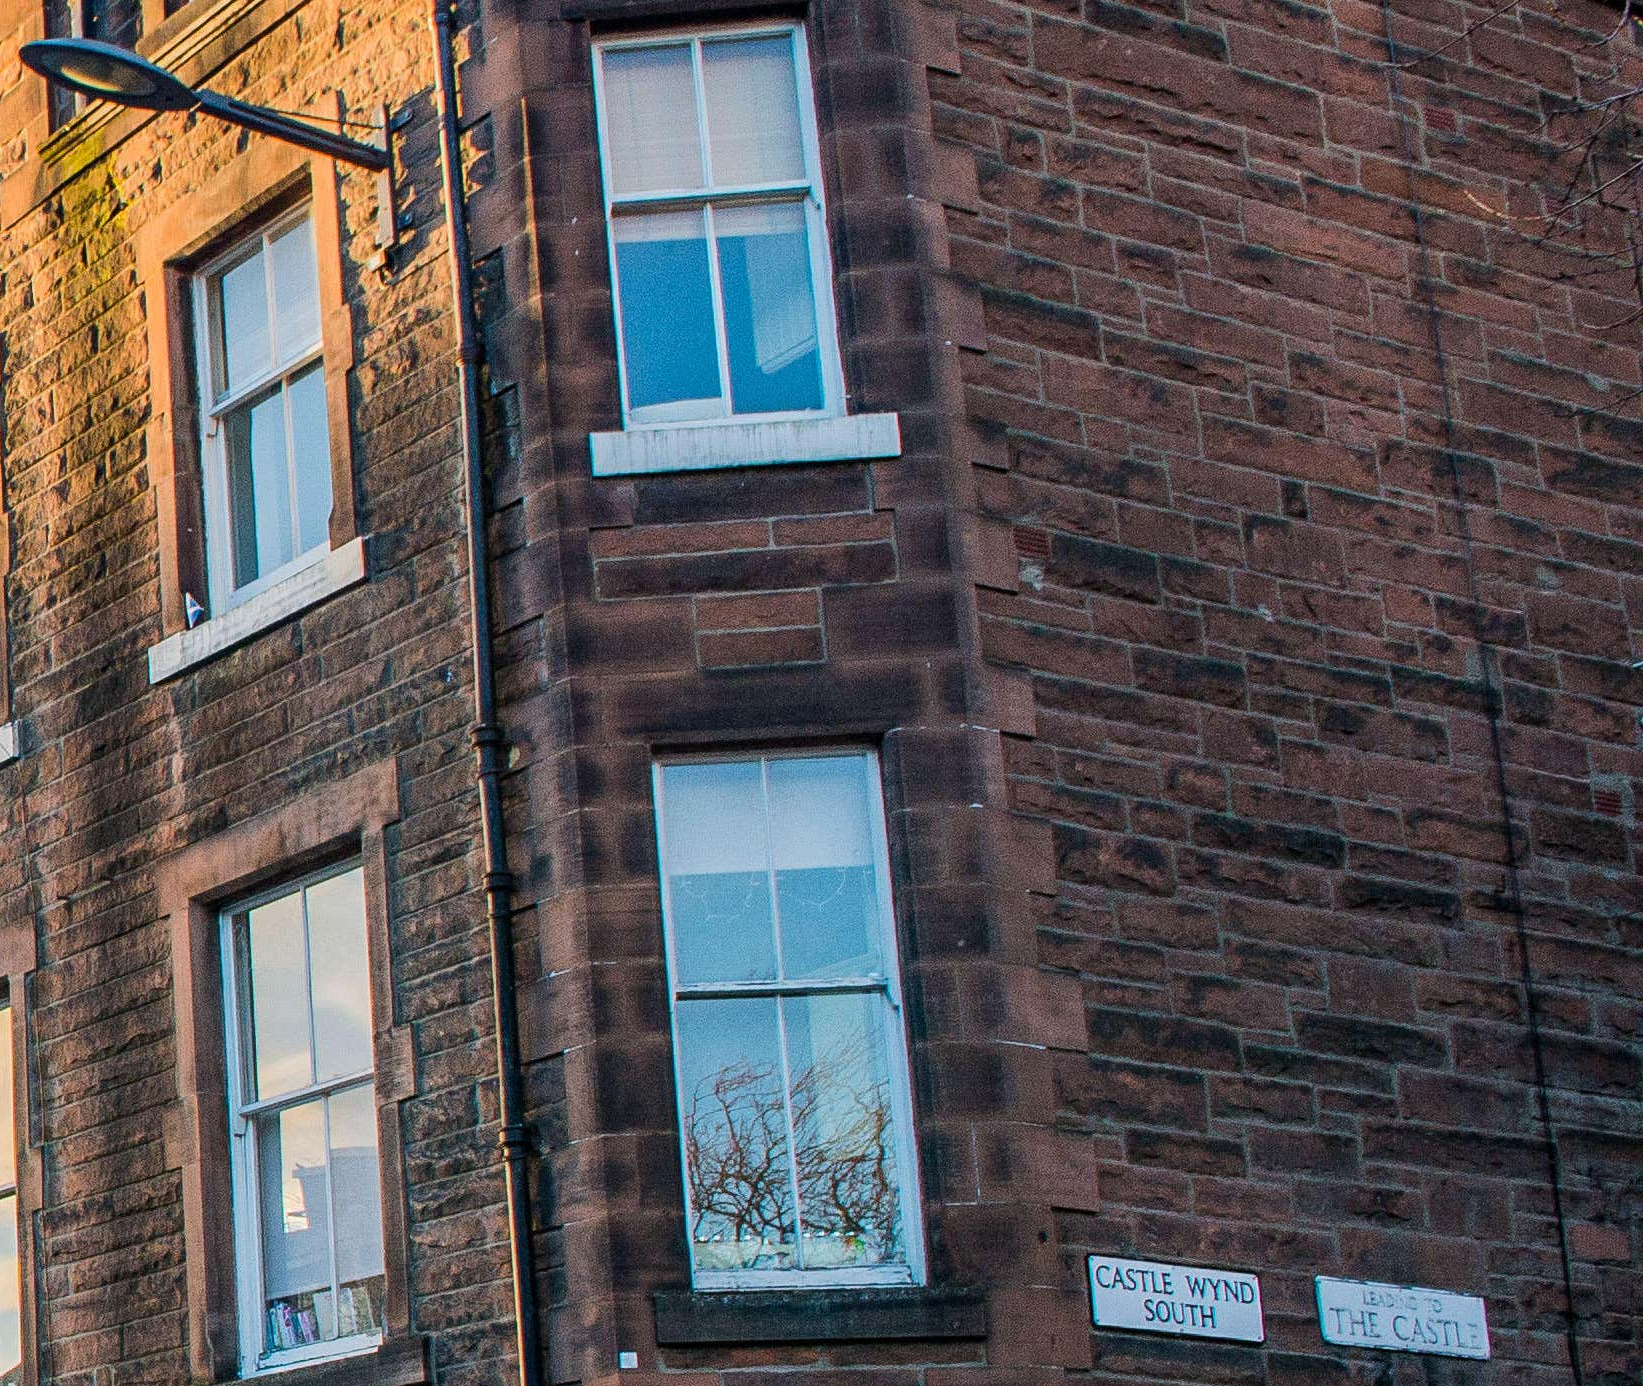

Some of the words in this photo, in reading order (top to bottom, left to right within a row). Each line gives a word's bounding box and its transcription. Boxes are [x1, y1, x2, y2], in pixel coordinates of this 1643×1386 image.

[1096, 1265, 1174, 1295] CASTLE
[1185, 1275, 1255, 1304] WYND
[1144, 1299, 1217, 1328] SOUTH
[1426, 1298, 1443, 1313] TO
[1329, 1307, 1380, 1338] THE
[1393, 1315, 1483, 1349] CASTLE
